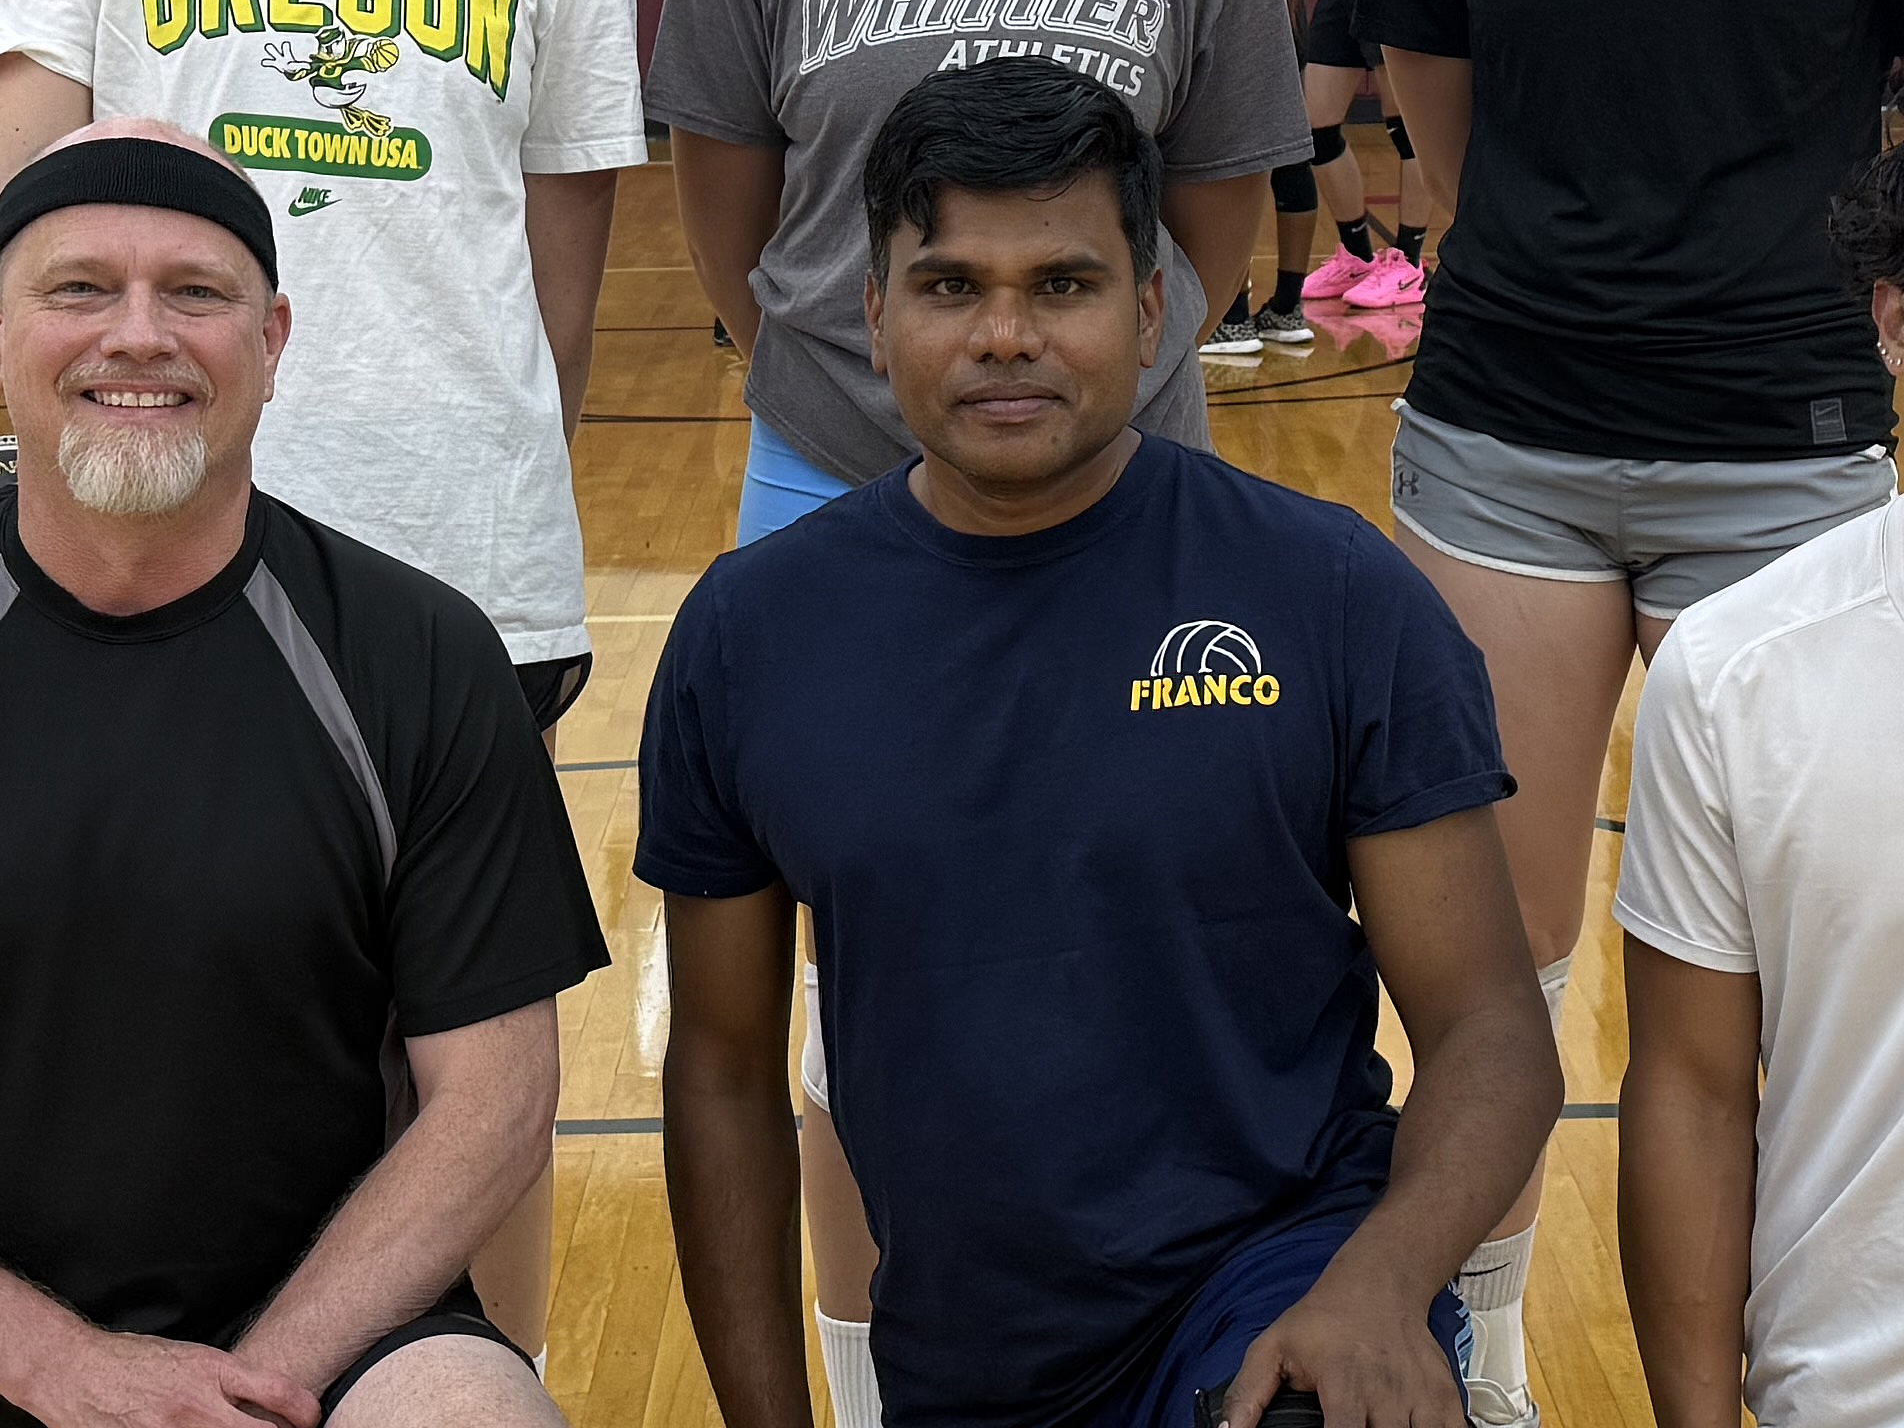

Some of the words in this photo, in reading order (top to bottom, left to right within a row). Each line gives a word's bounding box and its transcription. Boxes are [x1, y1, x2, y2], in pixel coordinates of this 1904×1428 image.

[223, 124, 291, 159] DUCK
[295, 129, 369, 166] TOWN
[371, 135, 418, 170] USA
[298, 186, 332, 205] NIKE
[1130, 674, 1280, 711] FRANCO
